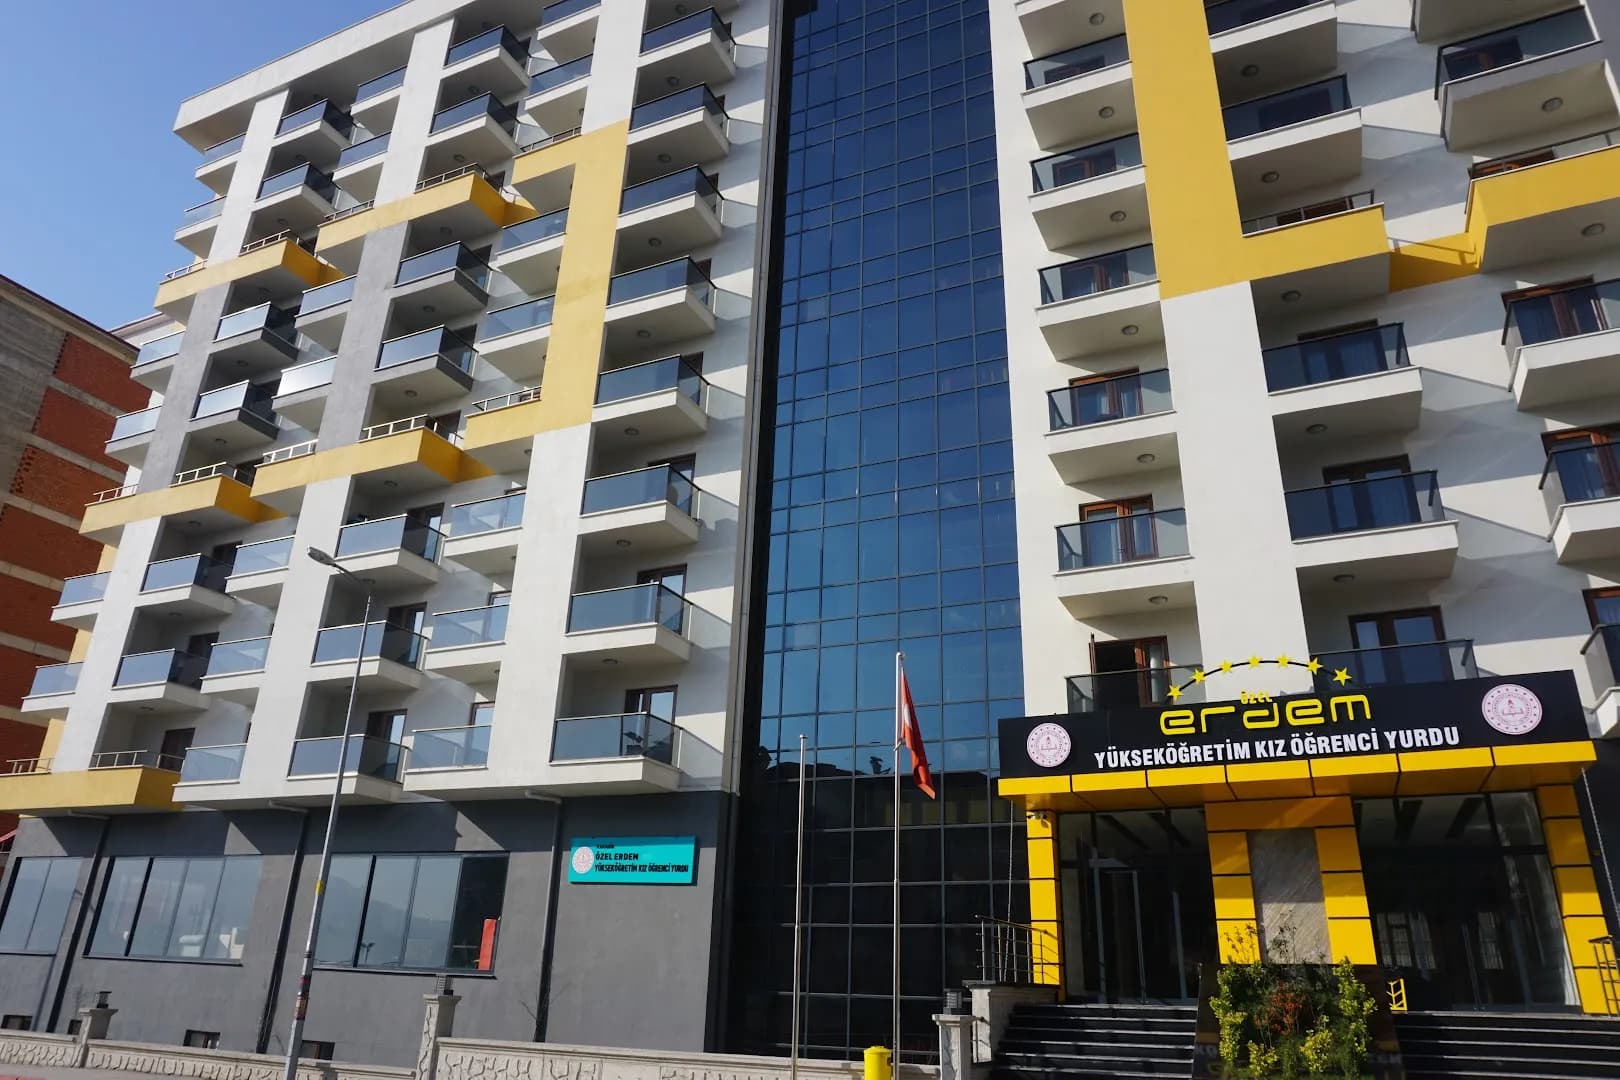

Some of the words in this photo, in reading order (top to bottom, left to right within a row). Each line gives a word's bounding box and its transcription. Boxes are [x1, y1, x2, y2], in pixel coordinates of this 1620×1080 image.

[1160, 694, 1372, 735] erdem
[1094, 739, 1250, 768] YÜKSEKÖĞRETİM
[1255, 739, 1287, 758] KIZ
[1290, 728, 1380, 756] ÖĞRENCİ
[1384, 726, 1460, 749] YURDU
[595, 851, 612, 861] ÖZEL
[614, 852, 639, 861] ERDEM
